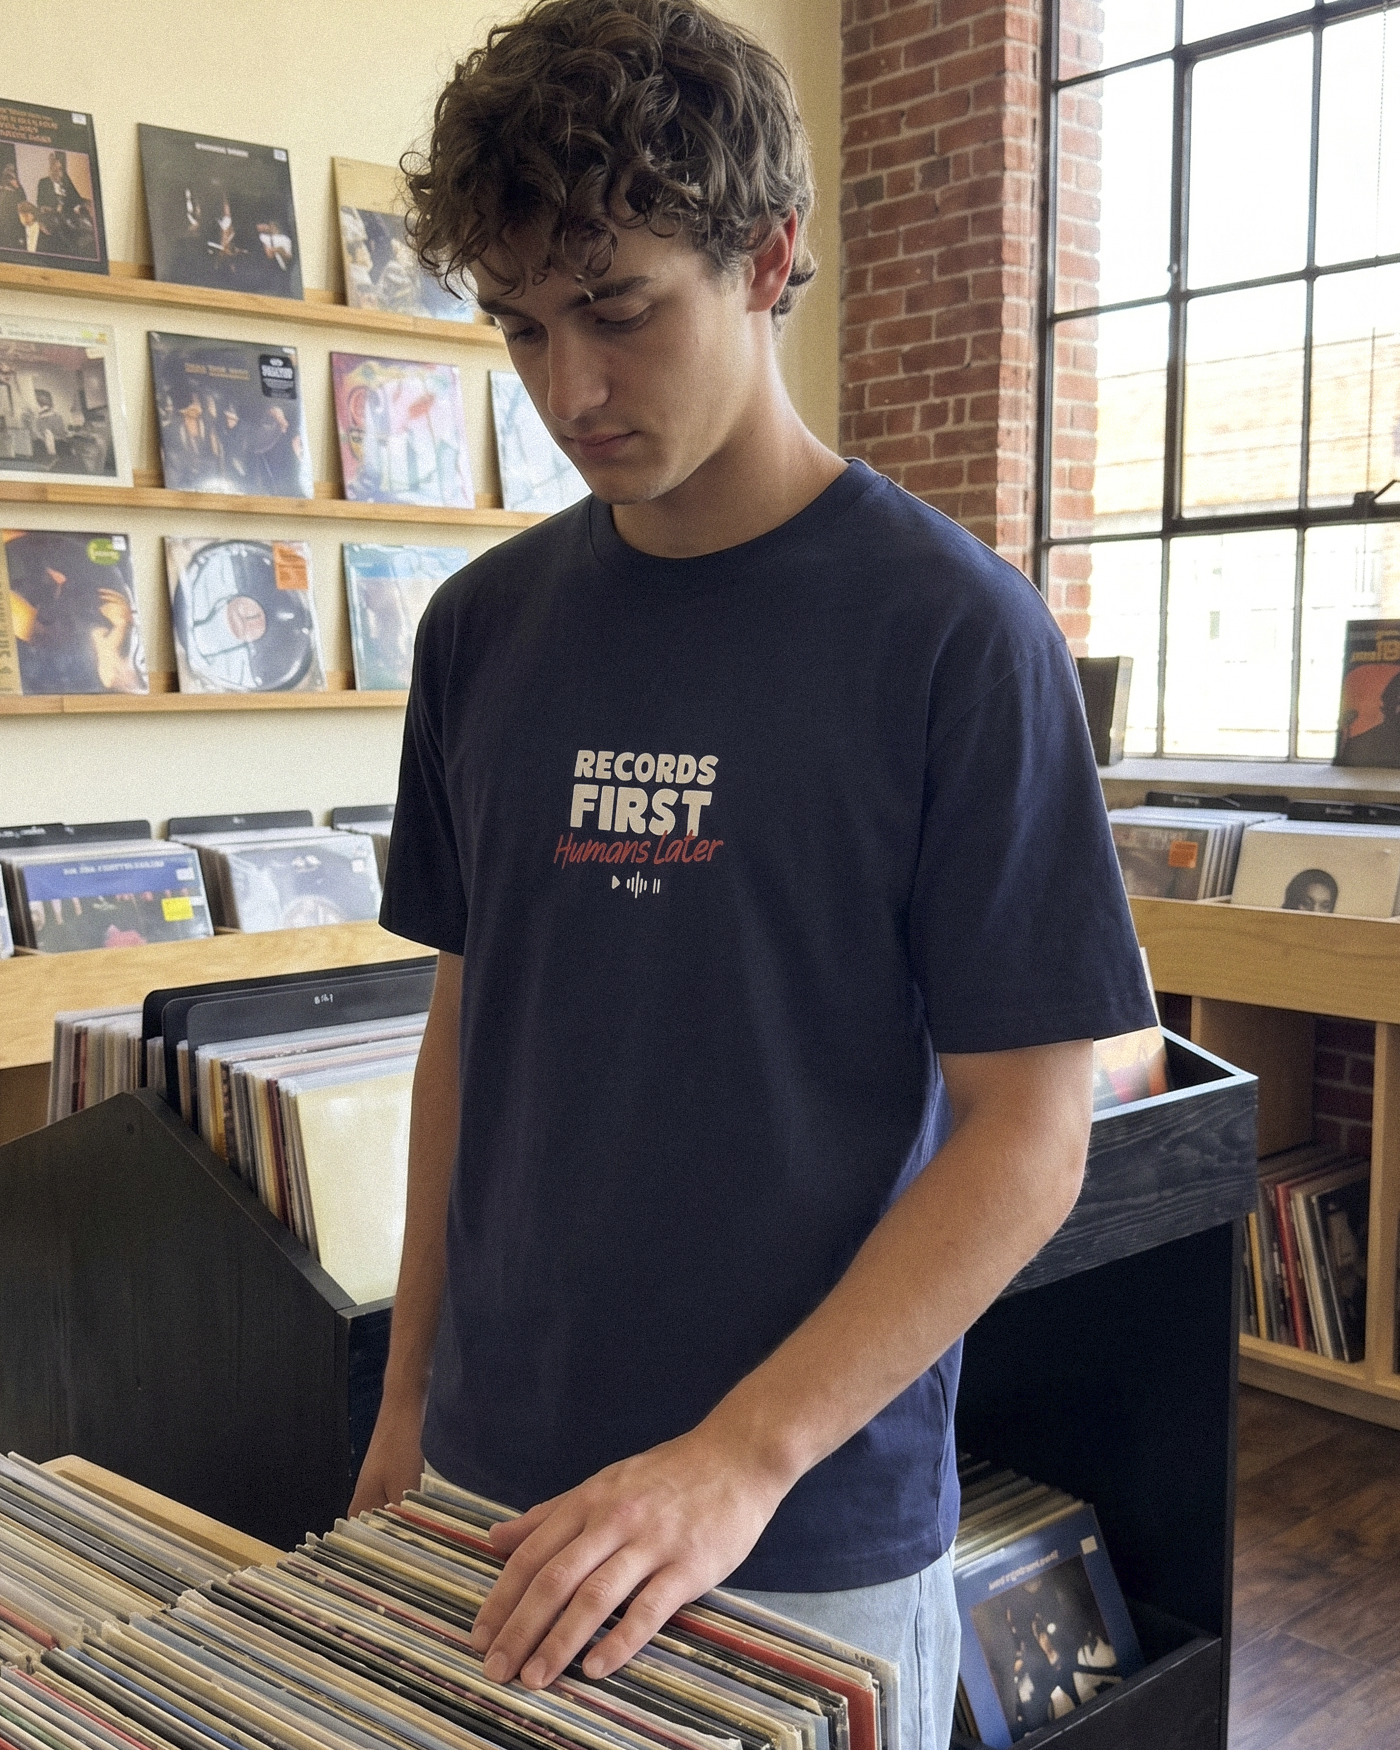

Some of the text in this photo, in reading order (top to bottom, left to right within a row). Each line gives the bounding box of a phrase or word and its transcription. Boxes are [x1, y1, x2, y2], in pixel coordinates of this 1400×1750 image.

[574, 750, 719, 786] RECORDS
[570, 784, 713, 837] FIRST
[553, 829, 724, 870] Humans Later
